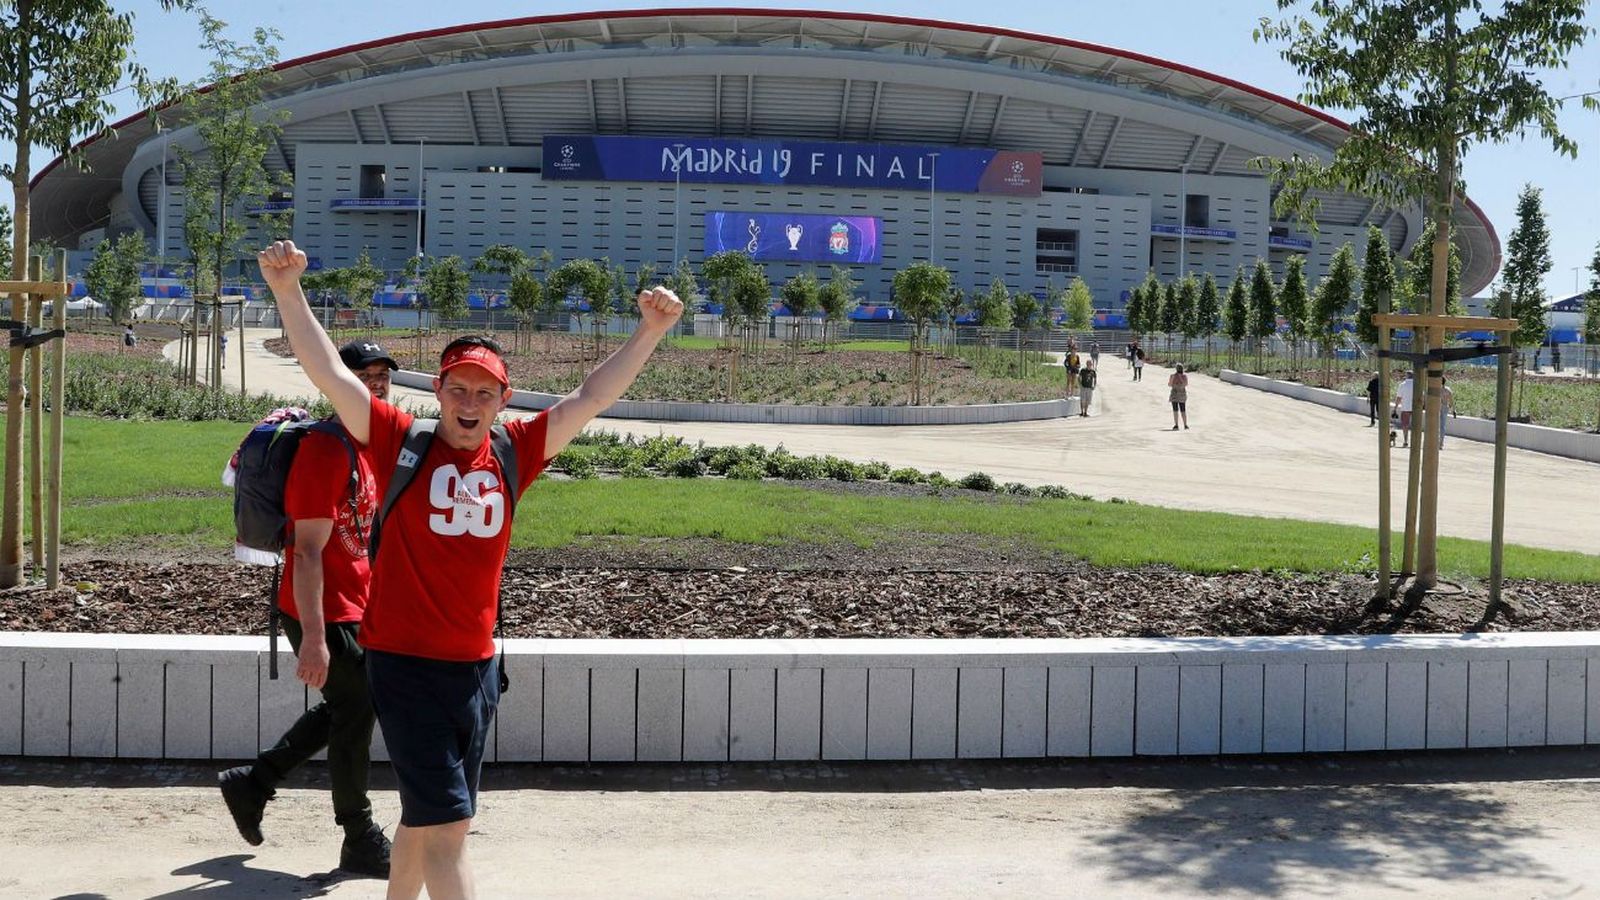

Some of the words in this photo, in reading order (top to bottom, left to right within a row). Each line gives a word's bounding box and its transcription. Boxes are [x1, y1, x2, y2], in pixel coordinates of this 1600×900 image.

[772, 149, 792, 178] 19
[810, 153, 932, 180] FINAL
[429, 463, 505, 539] 96
